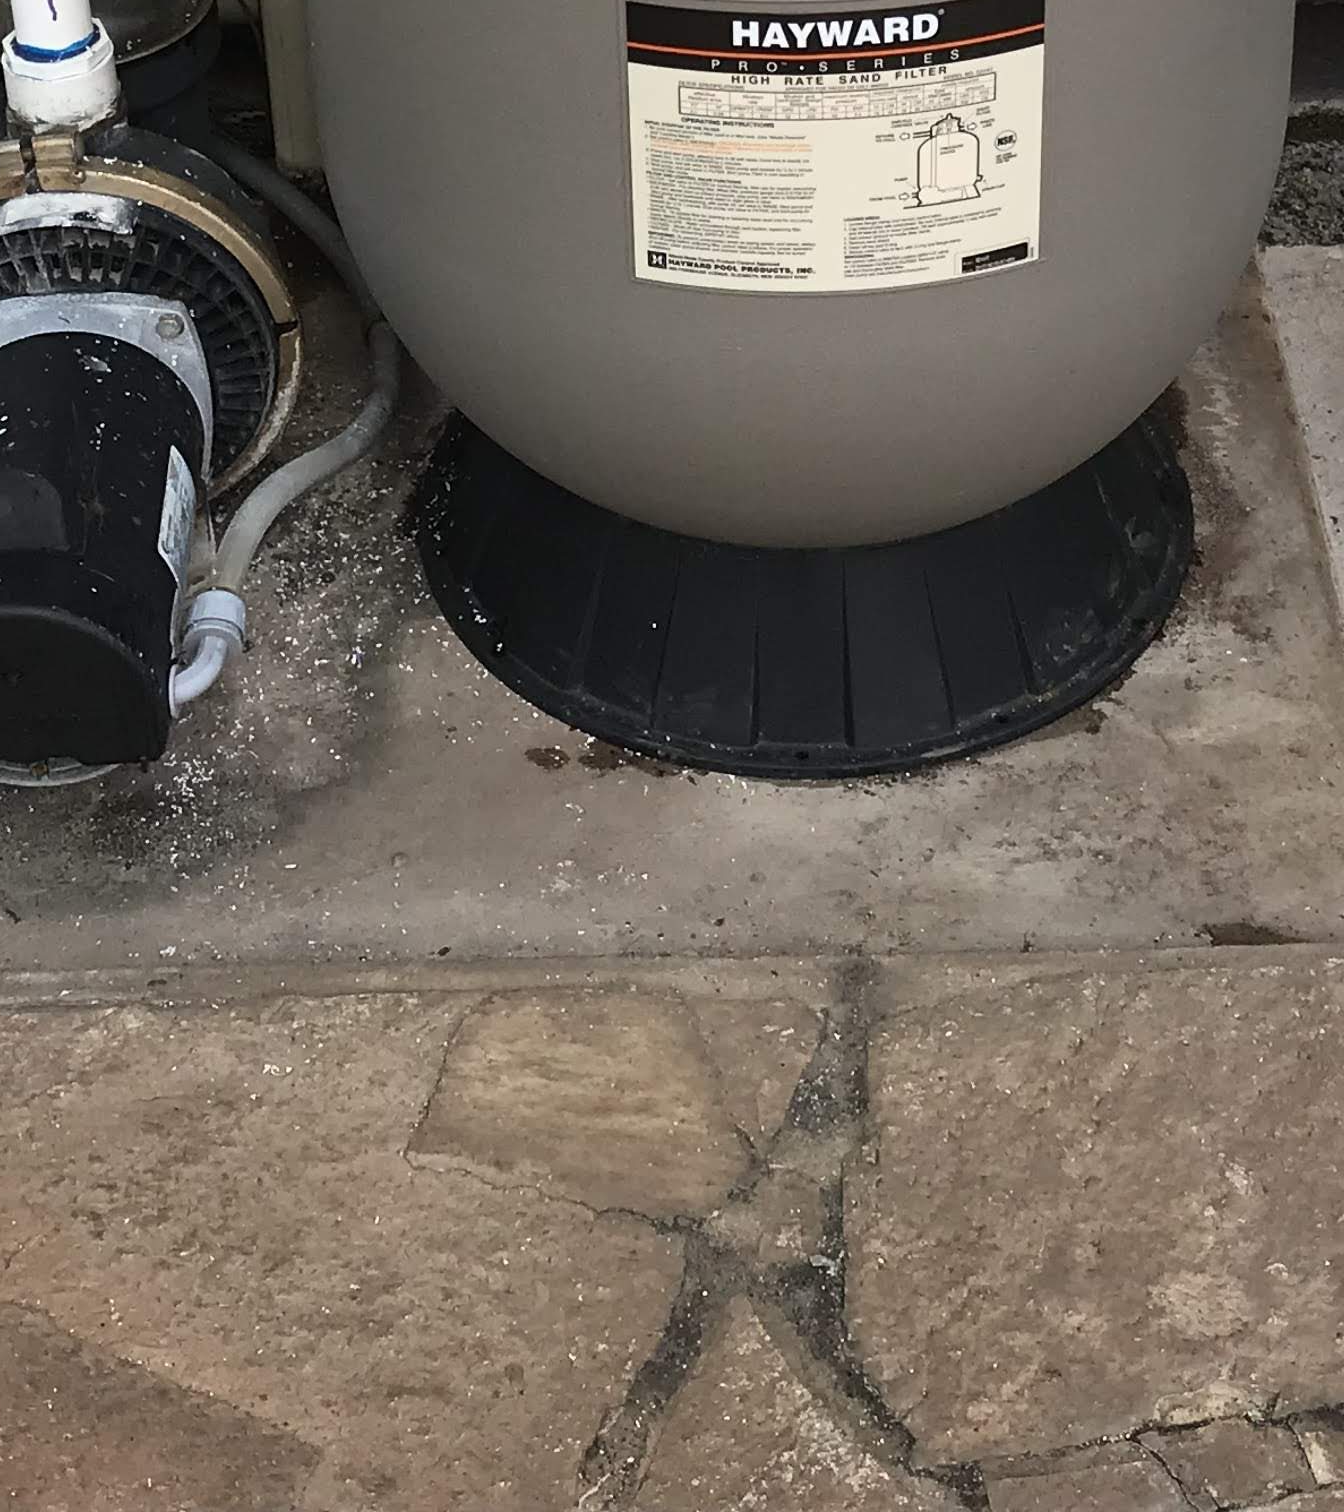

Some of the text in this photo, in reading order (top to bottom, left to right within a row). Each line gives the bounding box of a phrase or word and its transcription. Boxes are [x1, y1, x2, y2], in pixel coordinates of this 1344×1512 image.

[732, 13, 940, 49] HAYWARD
[731, 75, 771, 85] HIGH
[784, 76, 824, 86] RATE
[838, 73, 882, 85] SAND
[895, 66, 948, 81] FILTER
[668, 259, 712, 270] HAYWARD
[714, 264, 738, 273] POOL
[741, 267, 794, 275] PRODUCTS,
